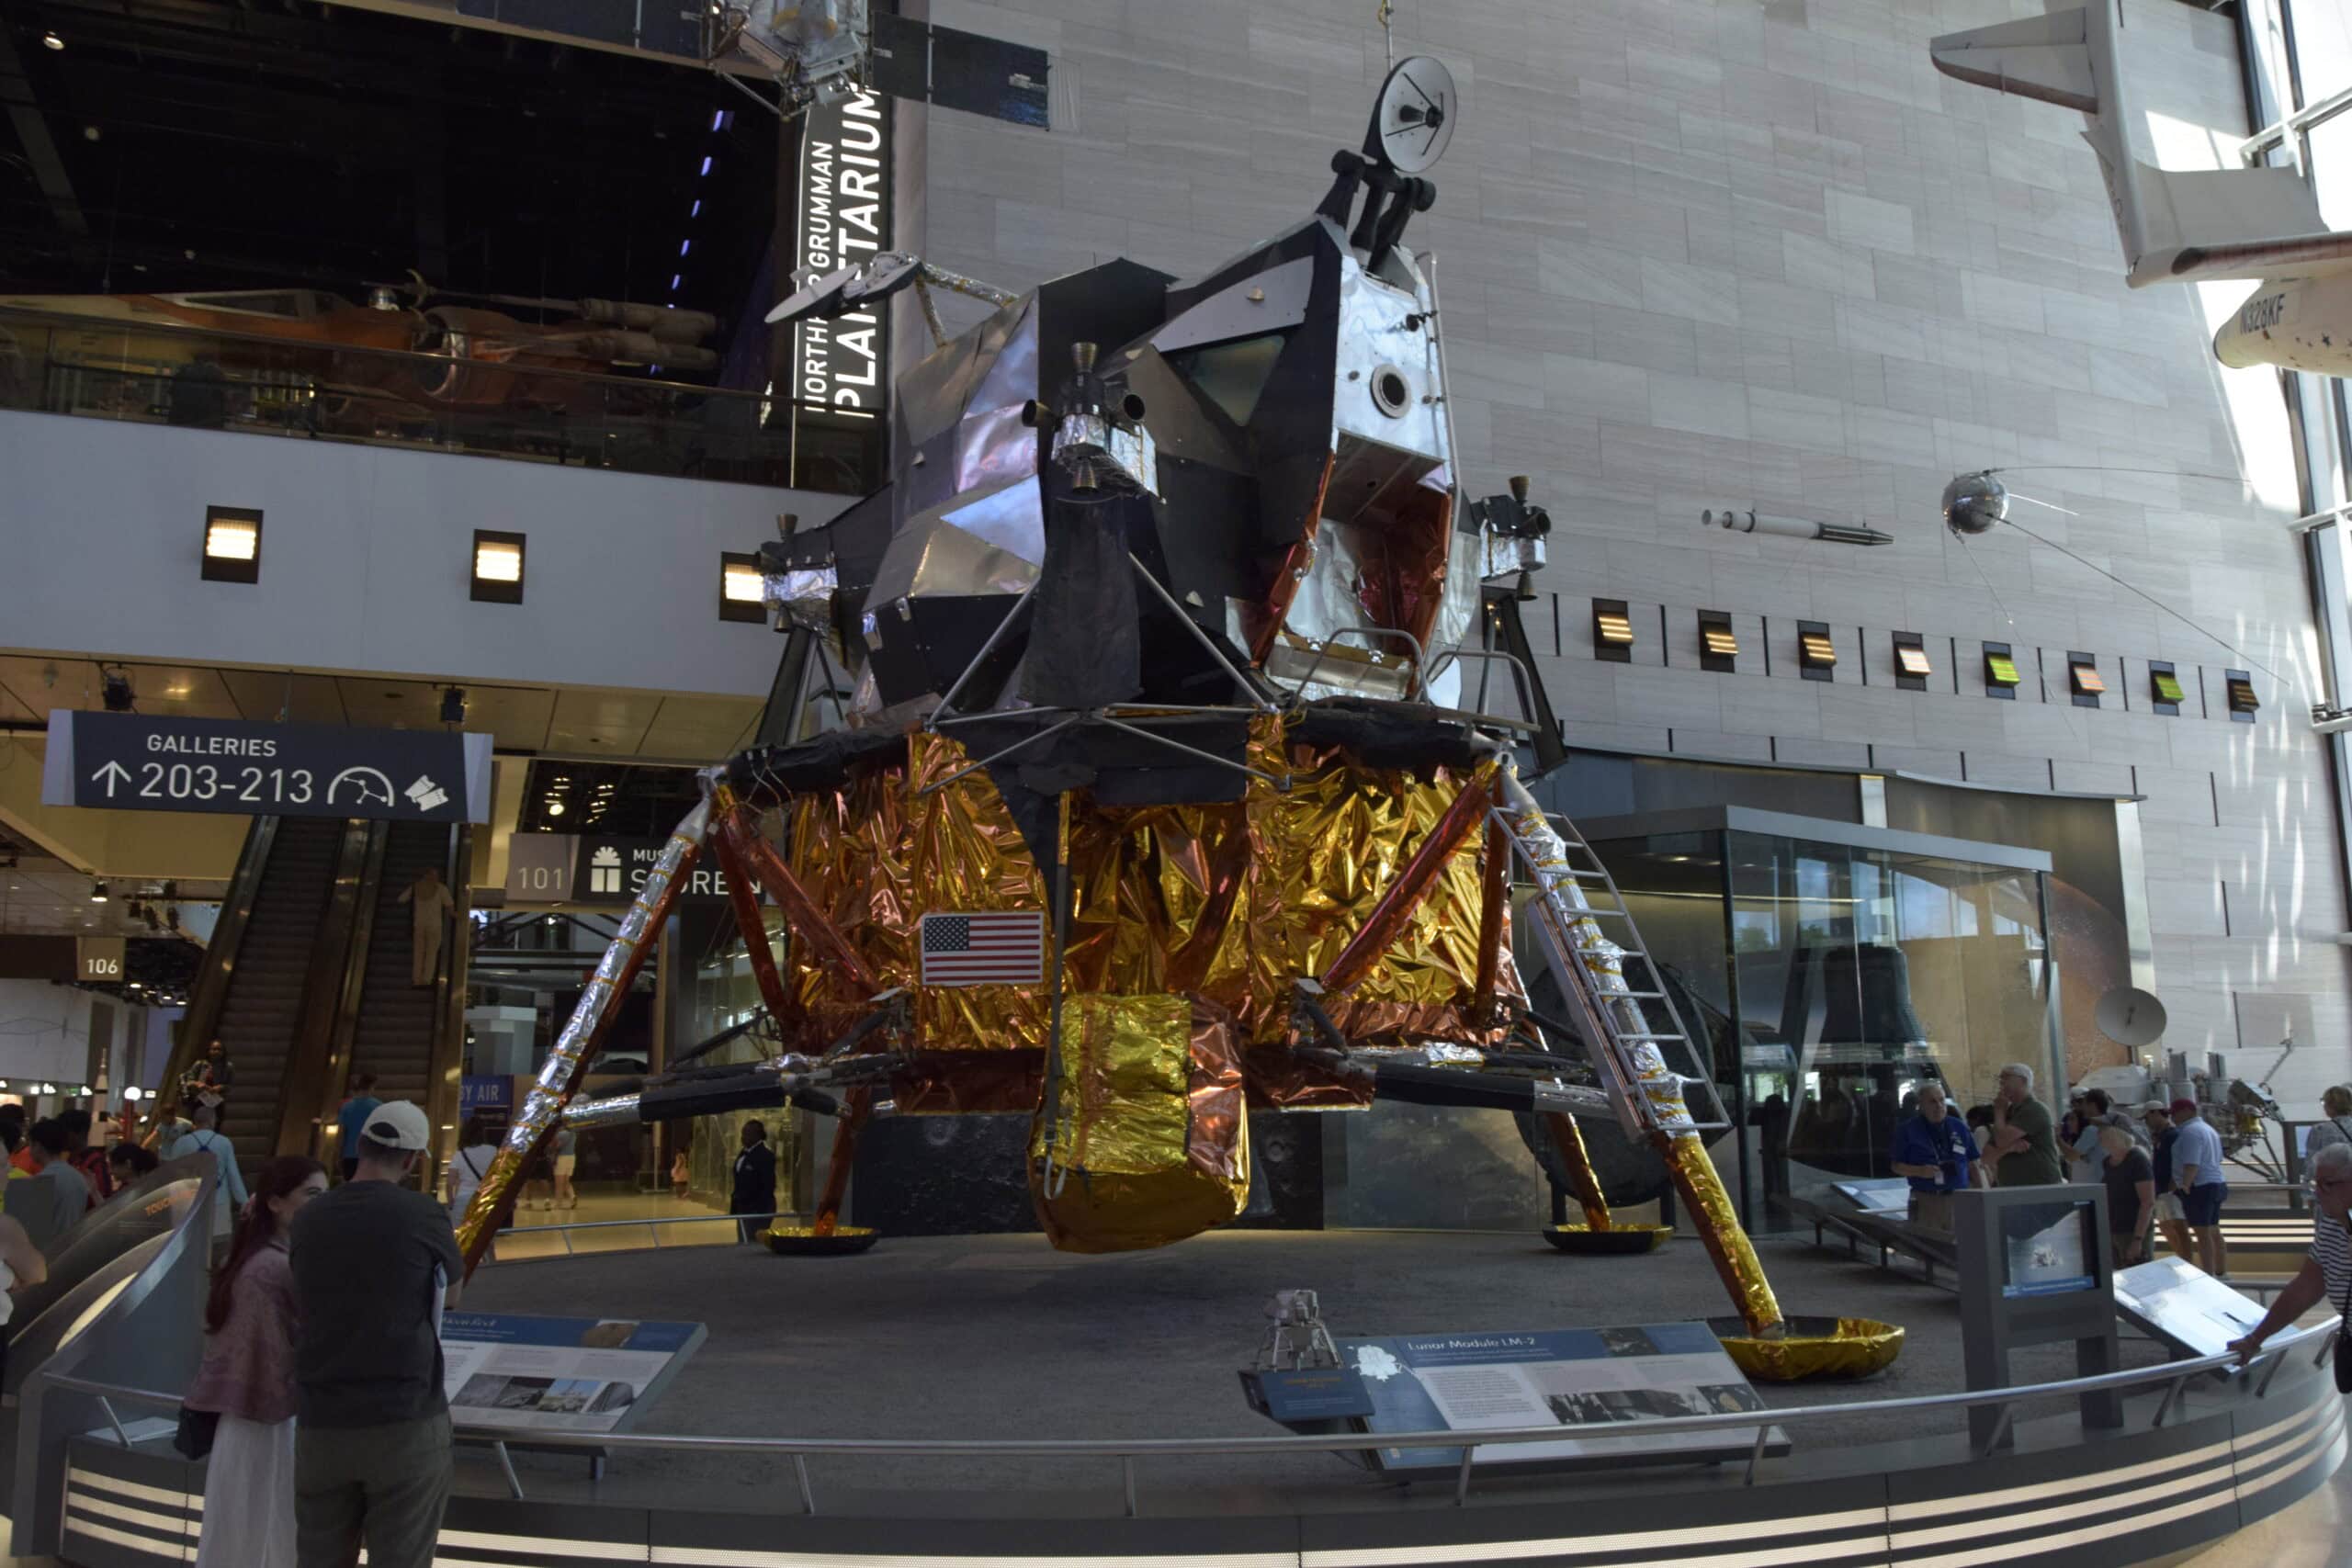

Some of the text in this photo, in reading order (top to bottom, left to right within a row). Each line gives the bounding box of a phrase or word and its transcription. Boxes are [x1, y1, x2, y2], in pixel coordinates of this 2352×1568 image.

[834, 82, 882, 419] PLATARIUM
[804, 141, 833, 412] NORTH GRUMMAN
[147, 734, 277, 758] GALLERIES
[139, 762, 313, 803] 203-213
[518, 867, 563, 890] 101
[629, 869, 729, 896] SRE
[86, 958, 119, 975] 106
[477, 1084, 500, 1102] AIR
[1407, 1341, 1445, 1351] Lunar
[1449, 1337, 1499, 1349] Module
